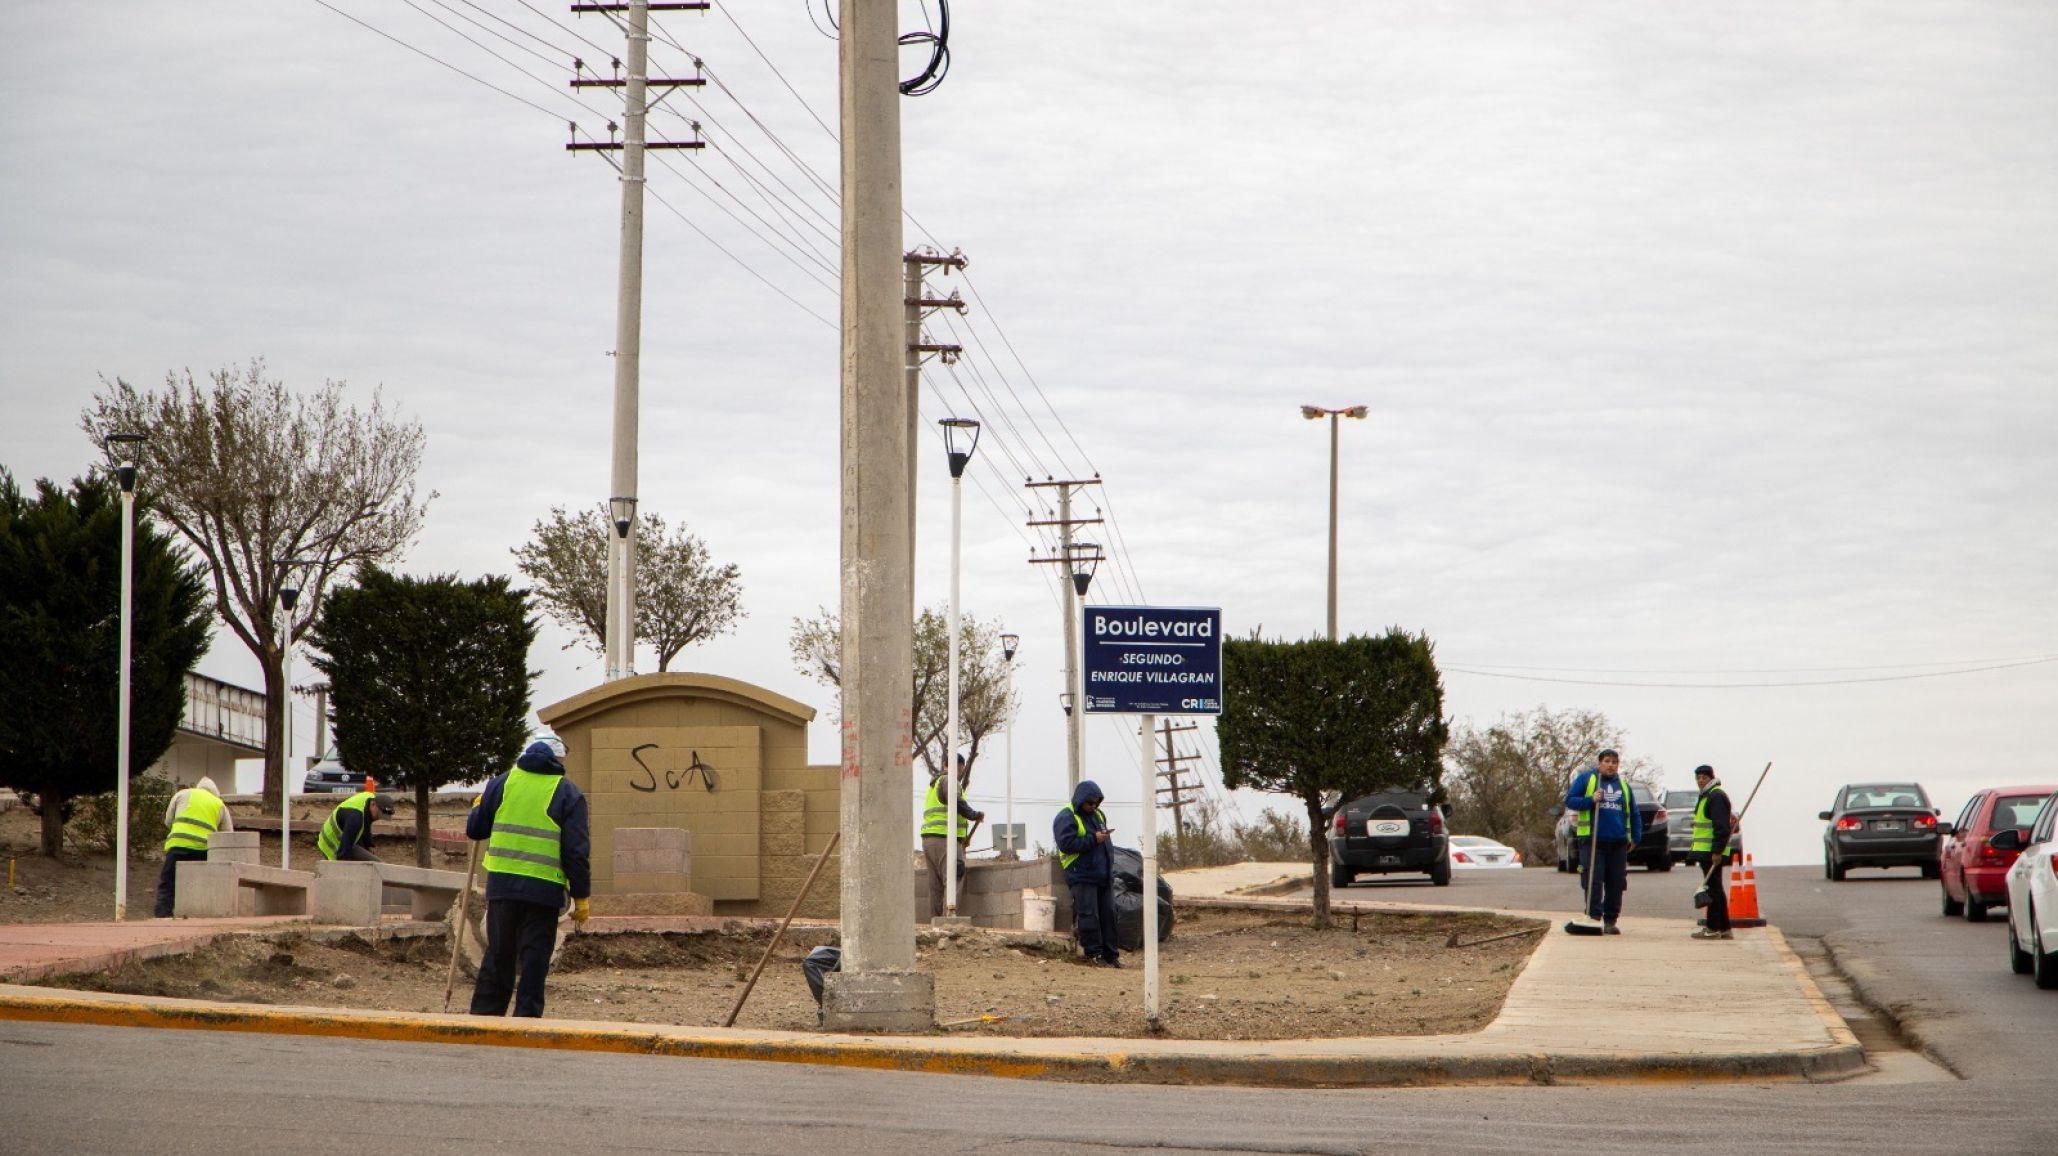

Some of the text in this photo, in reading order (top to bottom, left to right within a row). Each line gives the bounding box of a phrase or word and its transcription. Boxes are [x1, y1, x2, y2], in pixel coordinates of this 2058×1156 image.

[1095, 615, 1213, 637] Boulevard
[1122, 653, 1182, 665] SEGUNDO
[1091, 671, 1215, 684] ENRIQUE VILLAGRAN
